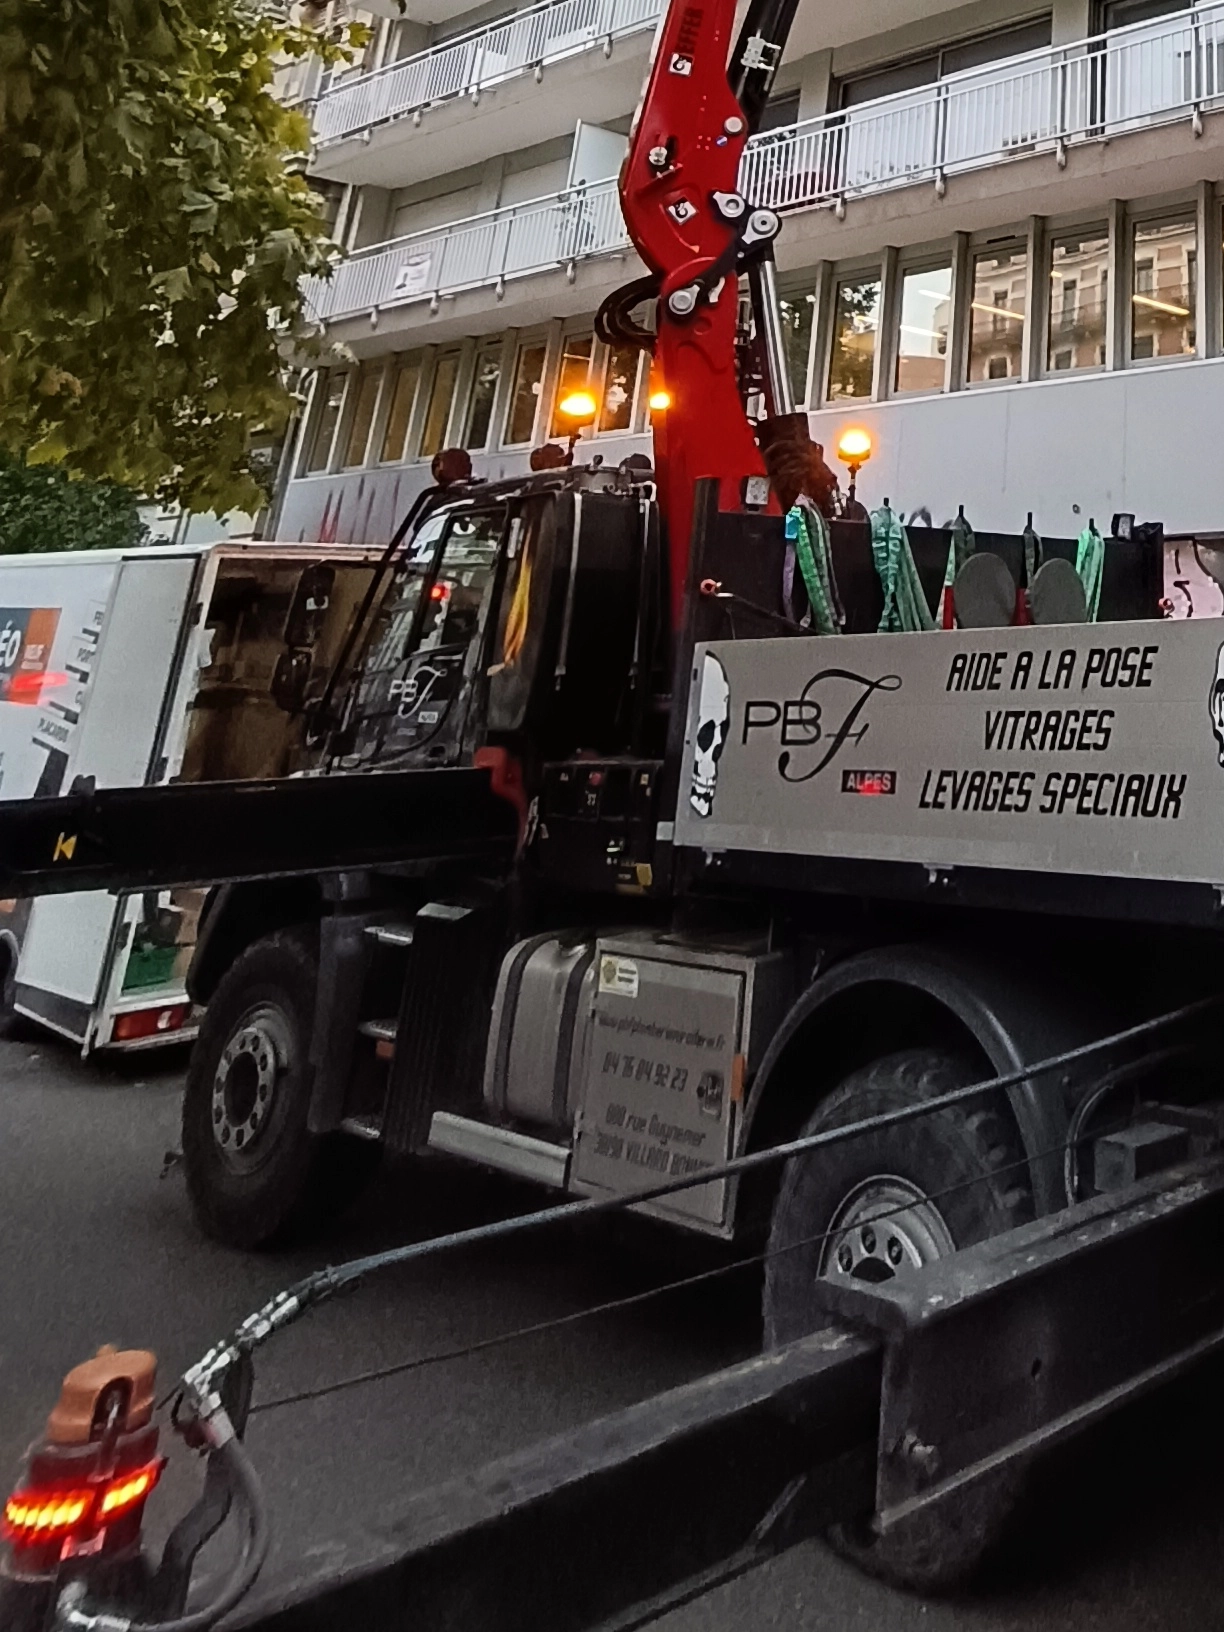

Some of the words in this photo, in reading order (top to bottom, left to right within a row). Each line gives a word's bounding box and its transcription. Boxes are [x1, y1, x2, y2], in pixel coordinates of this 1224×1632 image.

[945, 652, 1007, 692] AIDE
[1010, 651, 1031, 691] A
[1038, 649, 1074, 690] LA
[1080, 645, 1158, 689] POSE
[983, 709, 1114, 752] VITRAGES
[846, 772, 892, 791] ALPES
[919, 770, 1034, 813] LEVAGES
[1038, 772, 1187, 819] SPECIAUX
